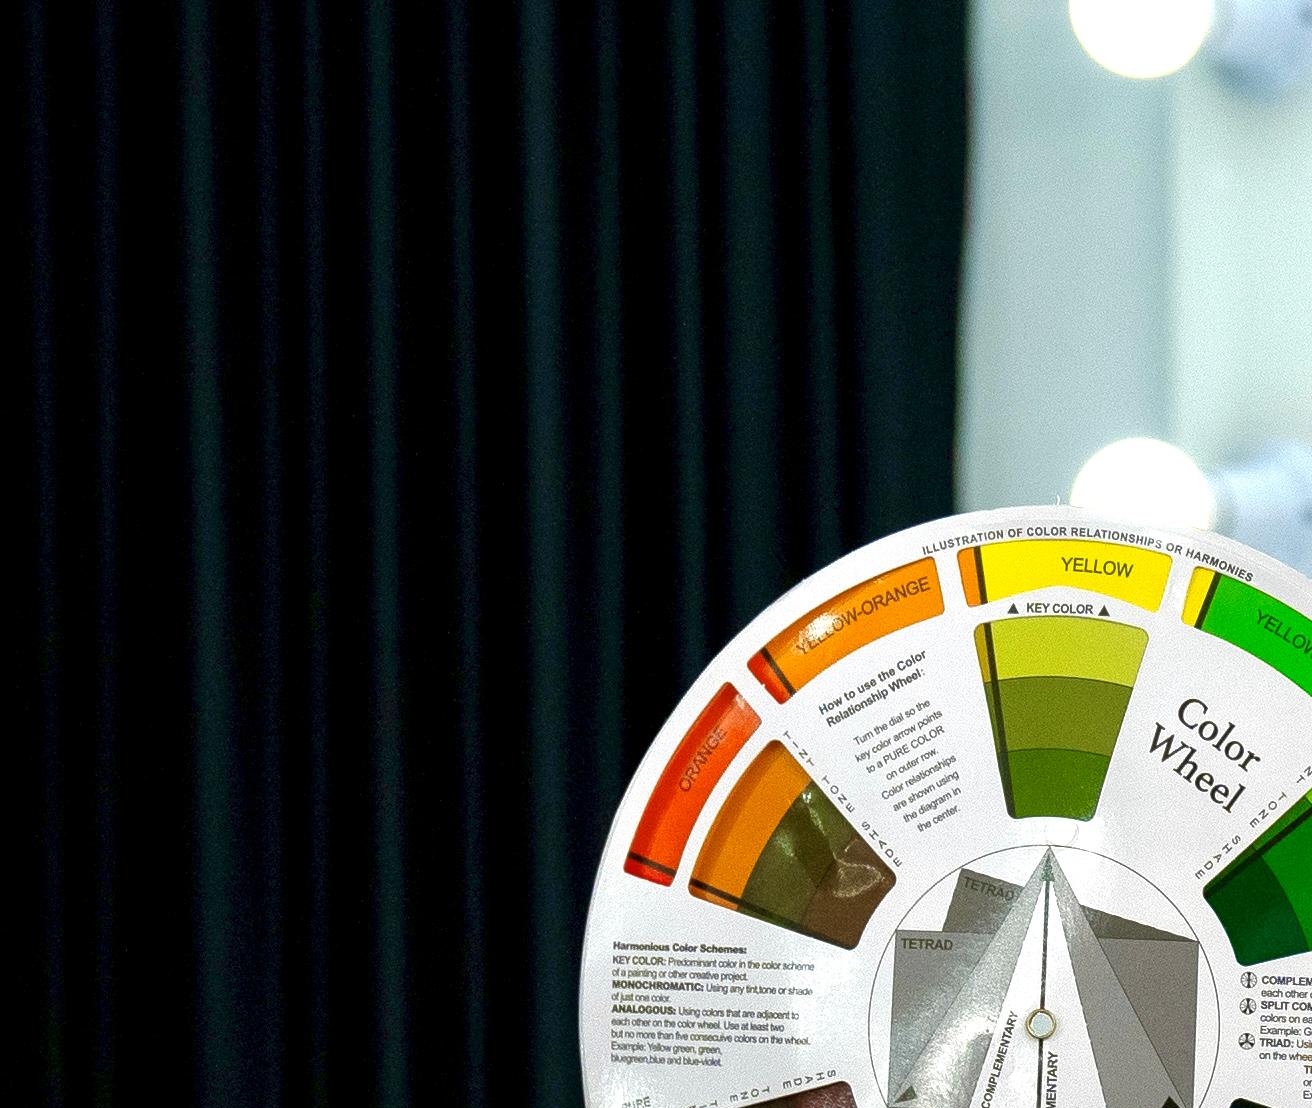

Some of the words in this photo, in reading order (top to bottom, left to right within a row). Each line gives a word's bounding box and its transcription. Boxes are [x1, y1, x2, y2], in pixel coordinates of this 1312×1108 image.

[923, 529, 1004, 556] ILLUSTRATION
[1008, 528, 1022, 537] OF
[1027, 526, 1066, 536] COLOR
[1071, 527, 1162, 549] RELATIONSHIPS
[1166, 543, 1182, 554] OR
[1185, 550, 1254, 582] HARMONIES
[1061, 557, 1133, 578] YELLOW
[1027, 603, 1050, 614] KEY
[1053, 604, 1093, 615] COLOR
[818, 695, 843, 714] How
[843, 689, 856, 700] to
[857, 678, 876, 693] use
[877, 666, 896, 681] the
[896, 649, 927, 671] Color
[825, 686, 889, 726] Relationship
[888, 666, 925, 692] Wheel:
[853, 730, 873, 745] Turn
[873, 721, 888, 734] the
[887, 712, 904, 726] dial
[904, 707, 915, 717] so
[916, 698, 930, 710] the
[854, 749, 871, 763] key
[870, 737, 892, 753] color
[892, 724, 916, 741] arrow
[916, 709, 943, 729] points
[1177, 698, 1260, 772] Color
[679, 724, 727, 791] ORANGE
[866, 763, 875, 773] to
[882, 744, 910, 763] PURE
[909, 725, 944, 748] COLOR
[885, 770, 897, 780] on
[897, 757, 920, 773] outer
[920, 748, 938, 761] row.
[881, 782, 904, 799] Color
[903, 754, 957, 786] relationships
[1149, 722, 1246, 813] Wheel
[784, 731, 815, 766] TINT
[822, 776, 855, 813] TONE
[861, 821, 902, 867] SHADE
[892, 799, 907, 811] are
[907, 783, 935, 802] shown
[935, 770, 959, 788] using
[902, 810, 917, 822] the
[917, 792, 953, 815] diagram
[951, 786, 960, 795] in
[916, 819, 931, 831] the
[931, 805, 960, 823] center.
[1250, 792, 1287, 828] TONE
[1195, 835, 1241, 880] SHADE
[964, 877, 1014, 901] TETRAD
[613, 941, 669, 951] Harmonious
[672, 943, 697, 952] Color
[699, 944, 746, 953] Schemes:
[901, 938, 953, 950] TETRAD
[612, 956, 629, 964] KEY
[632, 957, 666, 965] COLOR:
[612, 980, 703, 991] MONOCHROMATIC:
[1261, 989, 1282, 997] each
[1285, 990, 1308, 998] other
[611, 1004, 675, 1014] ANALOGOUS:
[1260, 1001, 1288, 1010] SPLIT
[1260, 1013, 1286, 1022] colors
[1259, 1038, 1293, 1048] TRIAD:
[1260, 1026, 1301, 1038] Example:
[730, 1087, 770, 1102] TONE
[783, 1070, 836, 1089] SHADE
